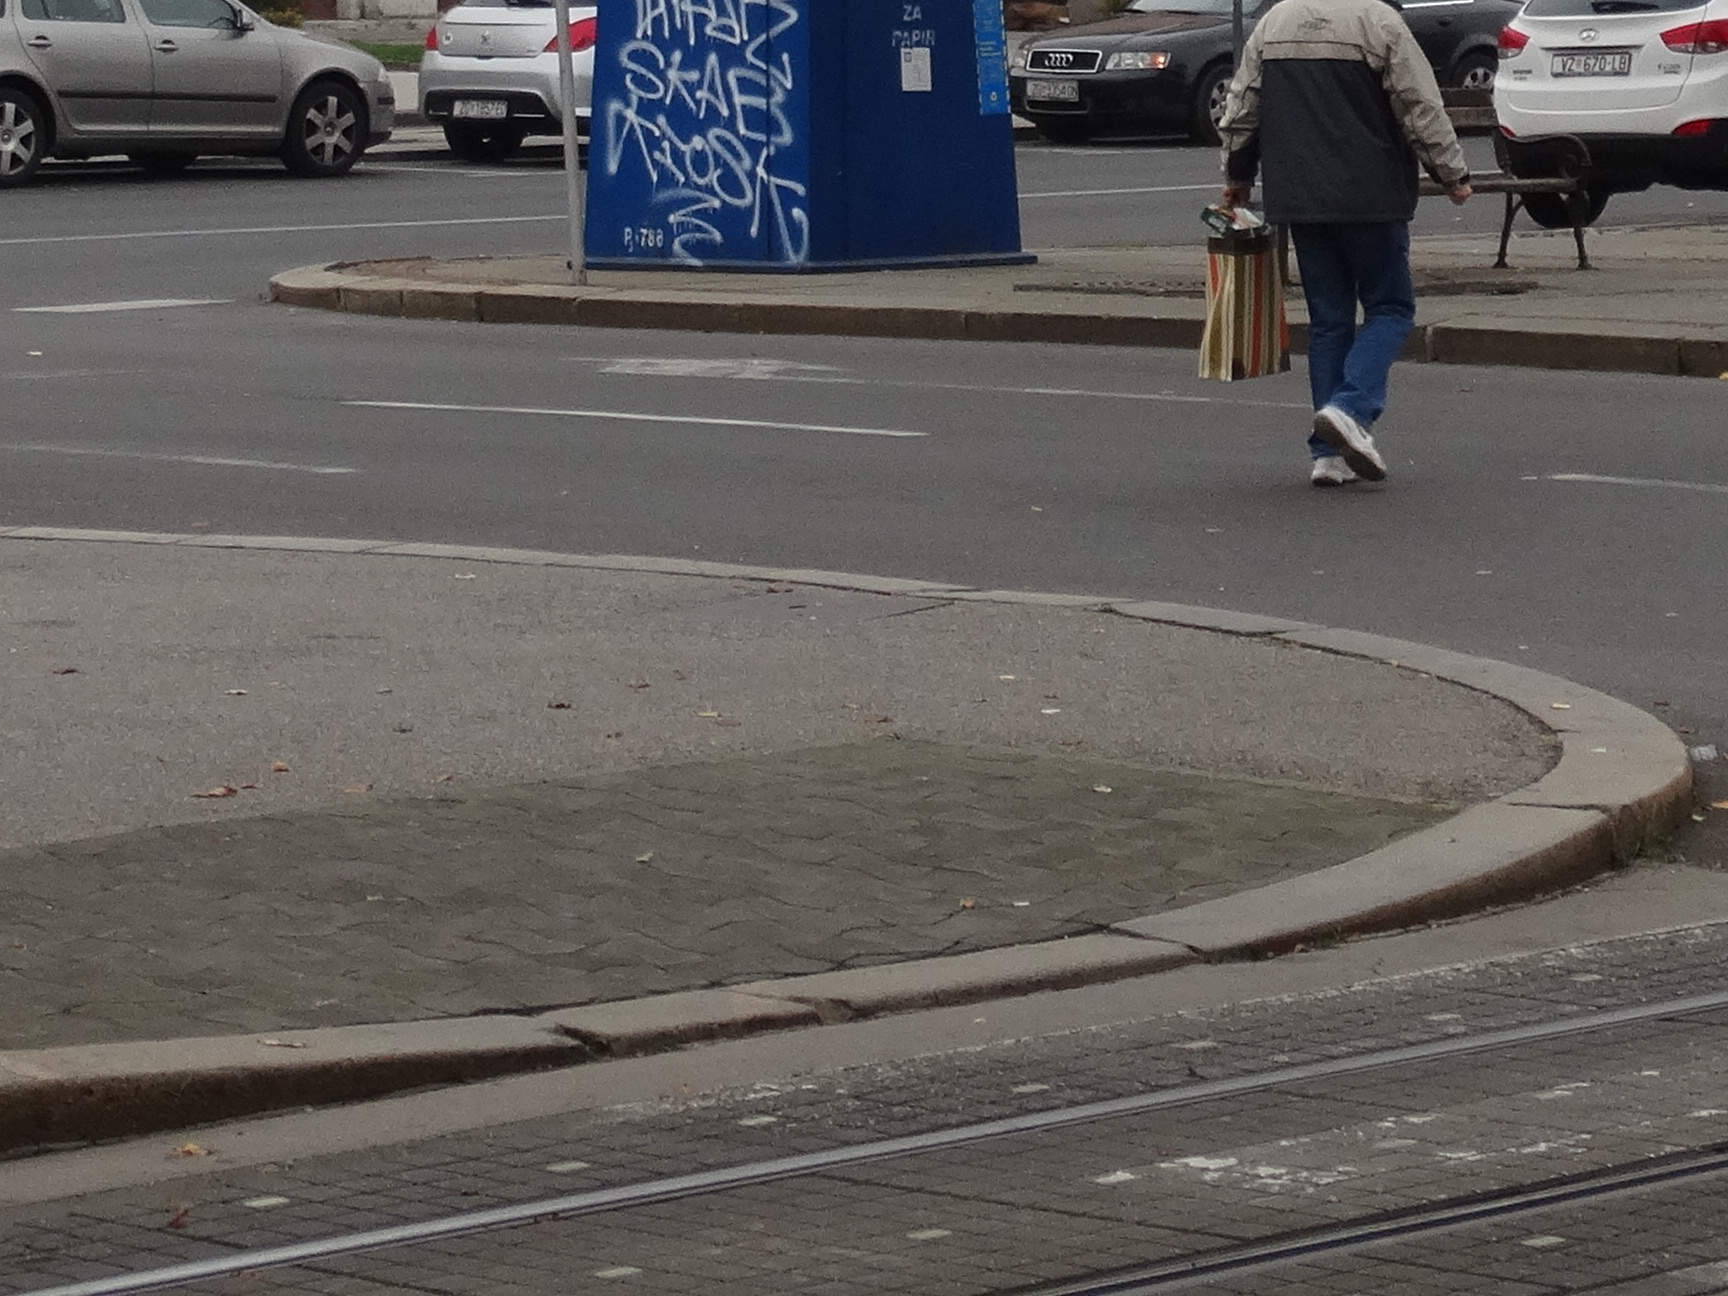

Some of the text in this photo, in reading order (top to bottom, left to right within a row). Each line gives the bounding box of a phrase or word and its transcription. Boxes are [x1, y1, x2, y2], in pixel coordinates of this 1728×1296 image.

[902, 5, 923, 22] ZA
[891, 28, 936, 48] PAPIR
[1561, 56, 1576, 72] VZ
